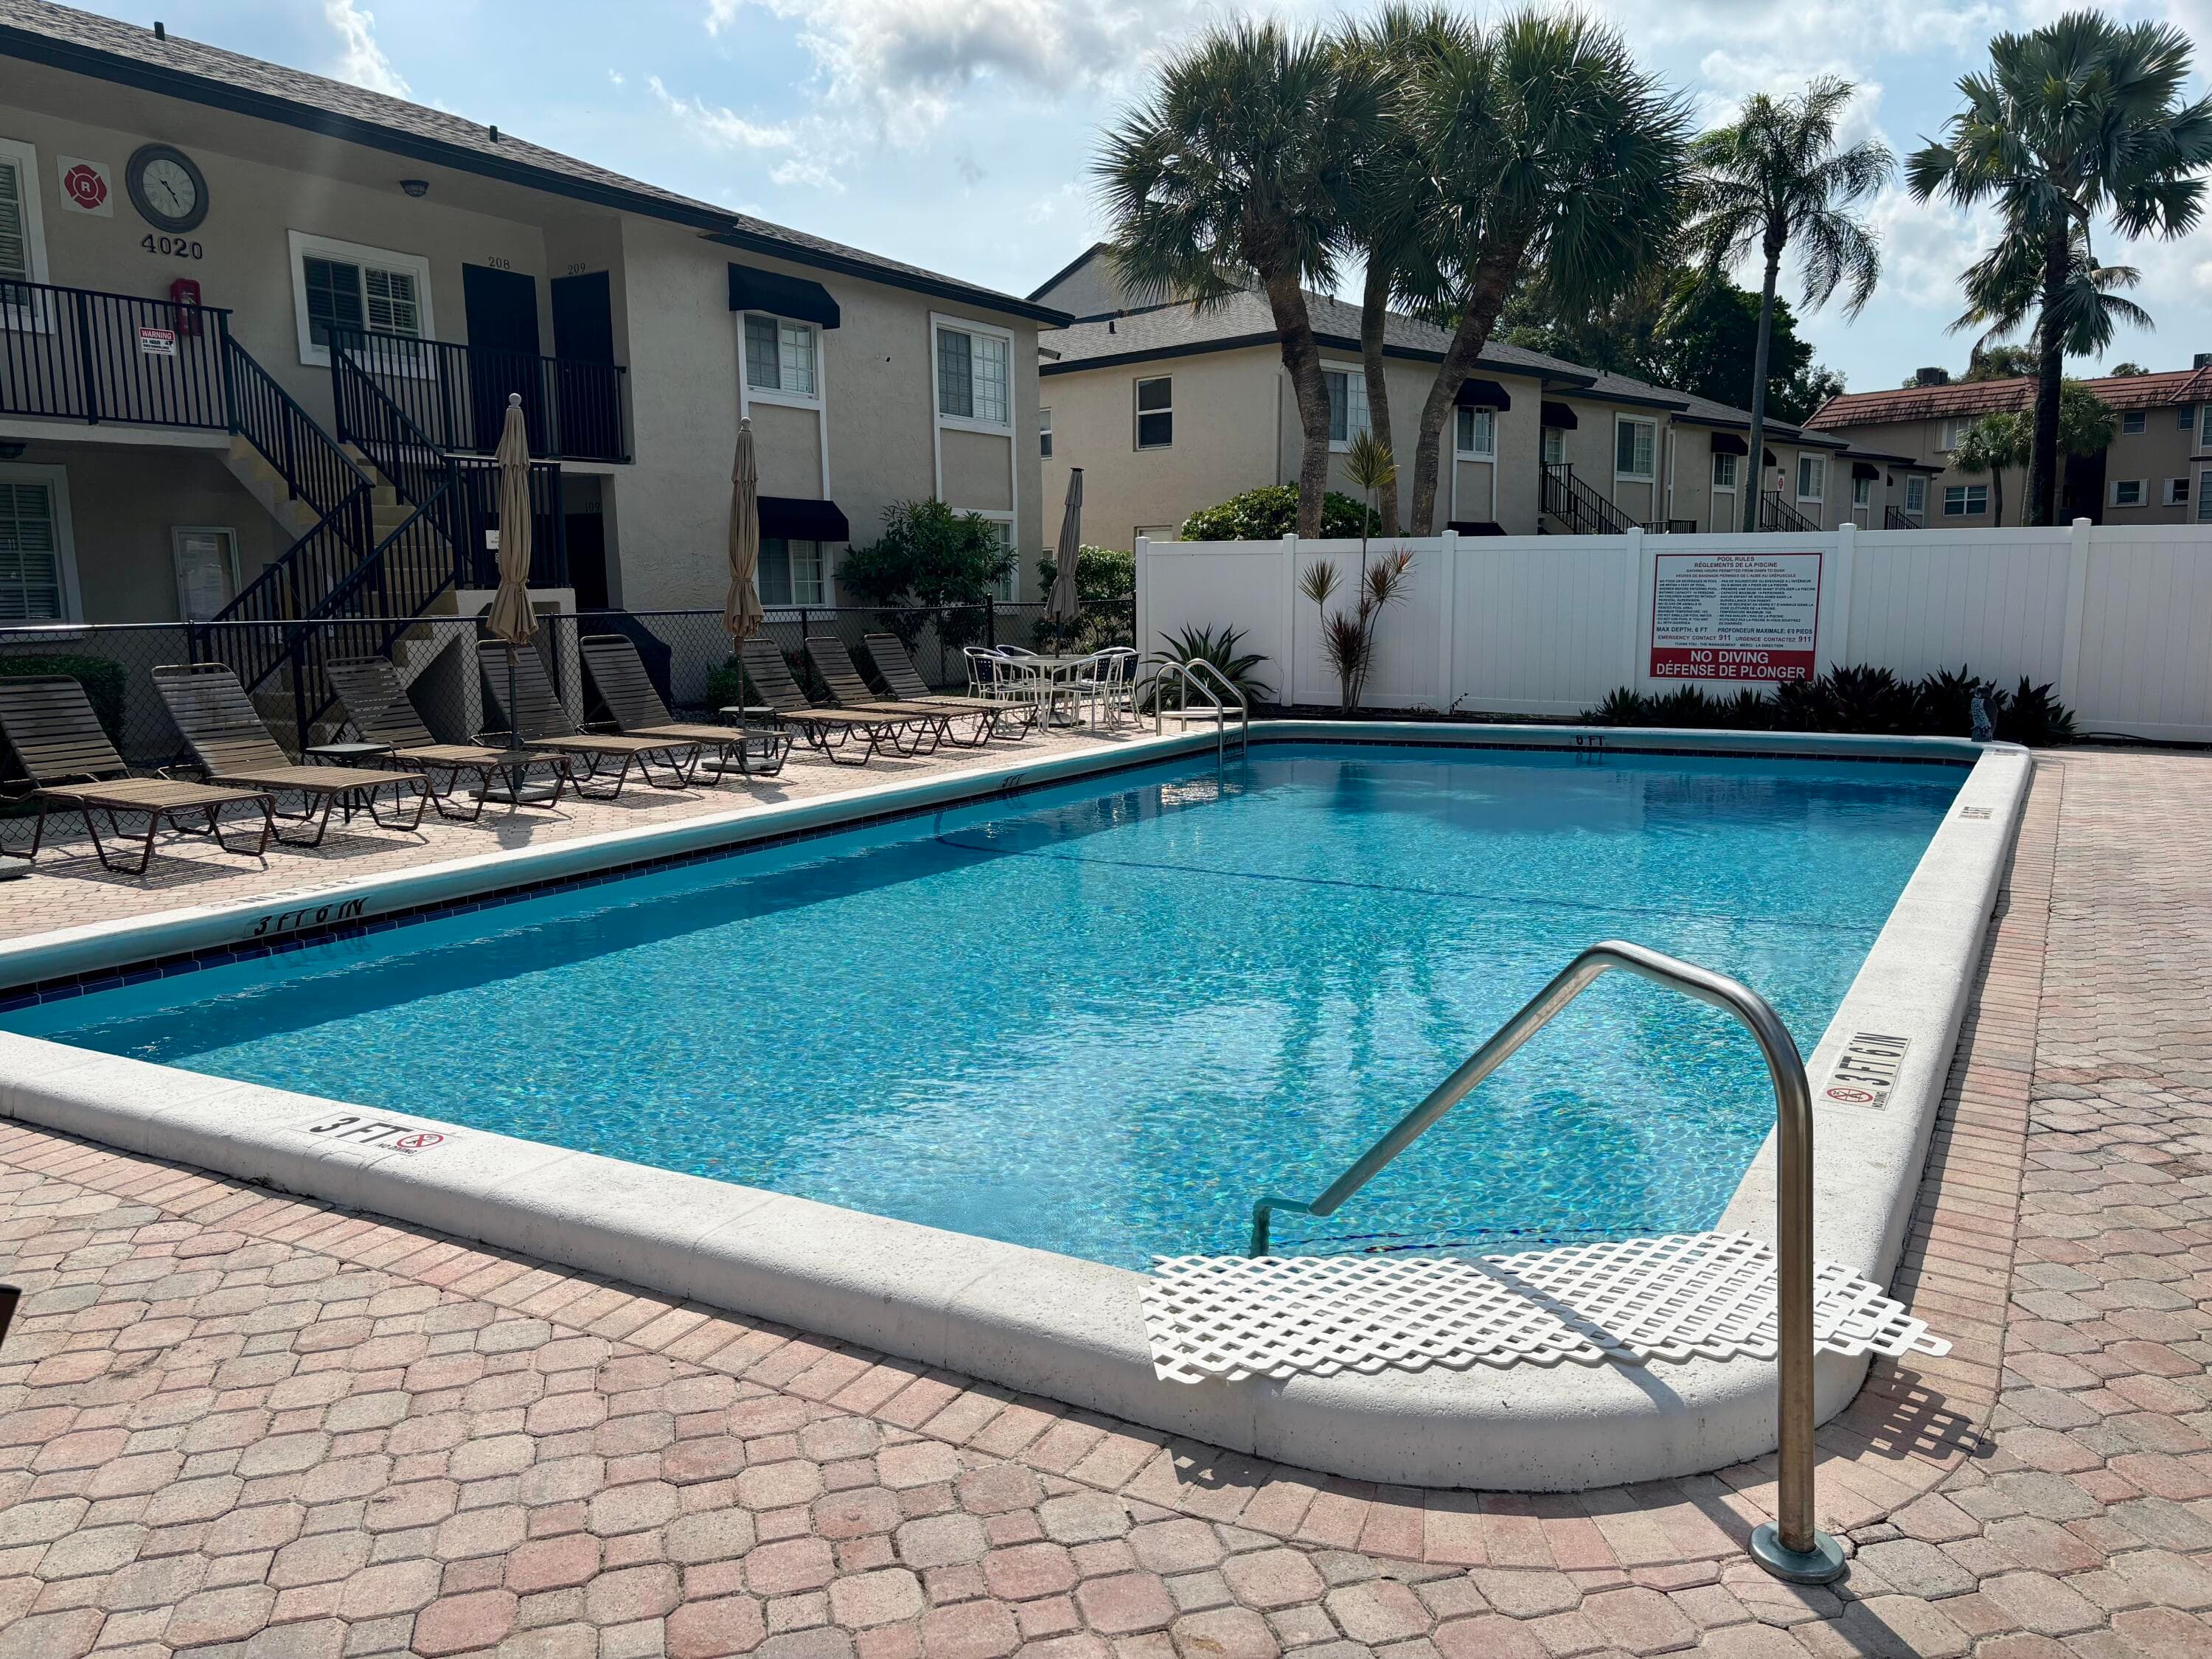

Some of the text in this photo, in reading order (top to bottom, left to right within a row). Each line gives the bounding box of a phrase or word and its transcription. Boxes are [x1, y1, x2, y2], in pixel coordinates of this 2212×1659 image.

[81, 181, 90, 192] R
[142, 234, 203, 260] 4020
[488, 257, 510, 270] 208
[567, 262, 585, 275] 209
[142, 330, 172, 340] WARNING
[1690, 650, 1769, 664] NO DIVING
[1656, 660, 1806, 678] DÉFENSE DE PLONGER
[1588, 735, 1605, 746] FT
[254, 896, 370, 936] 3 FT 6 IN
[1852, 1032, 1908, 1048] IN
[1839, 1056, 1896, 1075] FT
[1834, 1074, 1891, 1086] 3
[309, 1117, 414, 1144] 3 FT
[388, 1145, 417, 1155] DIVING
